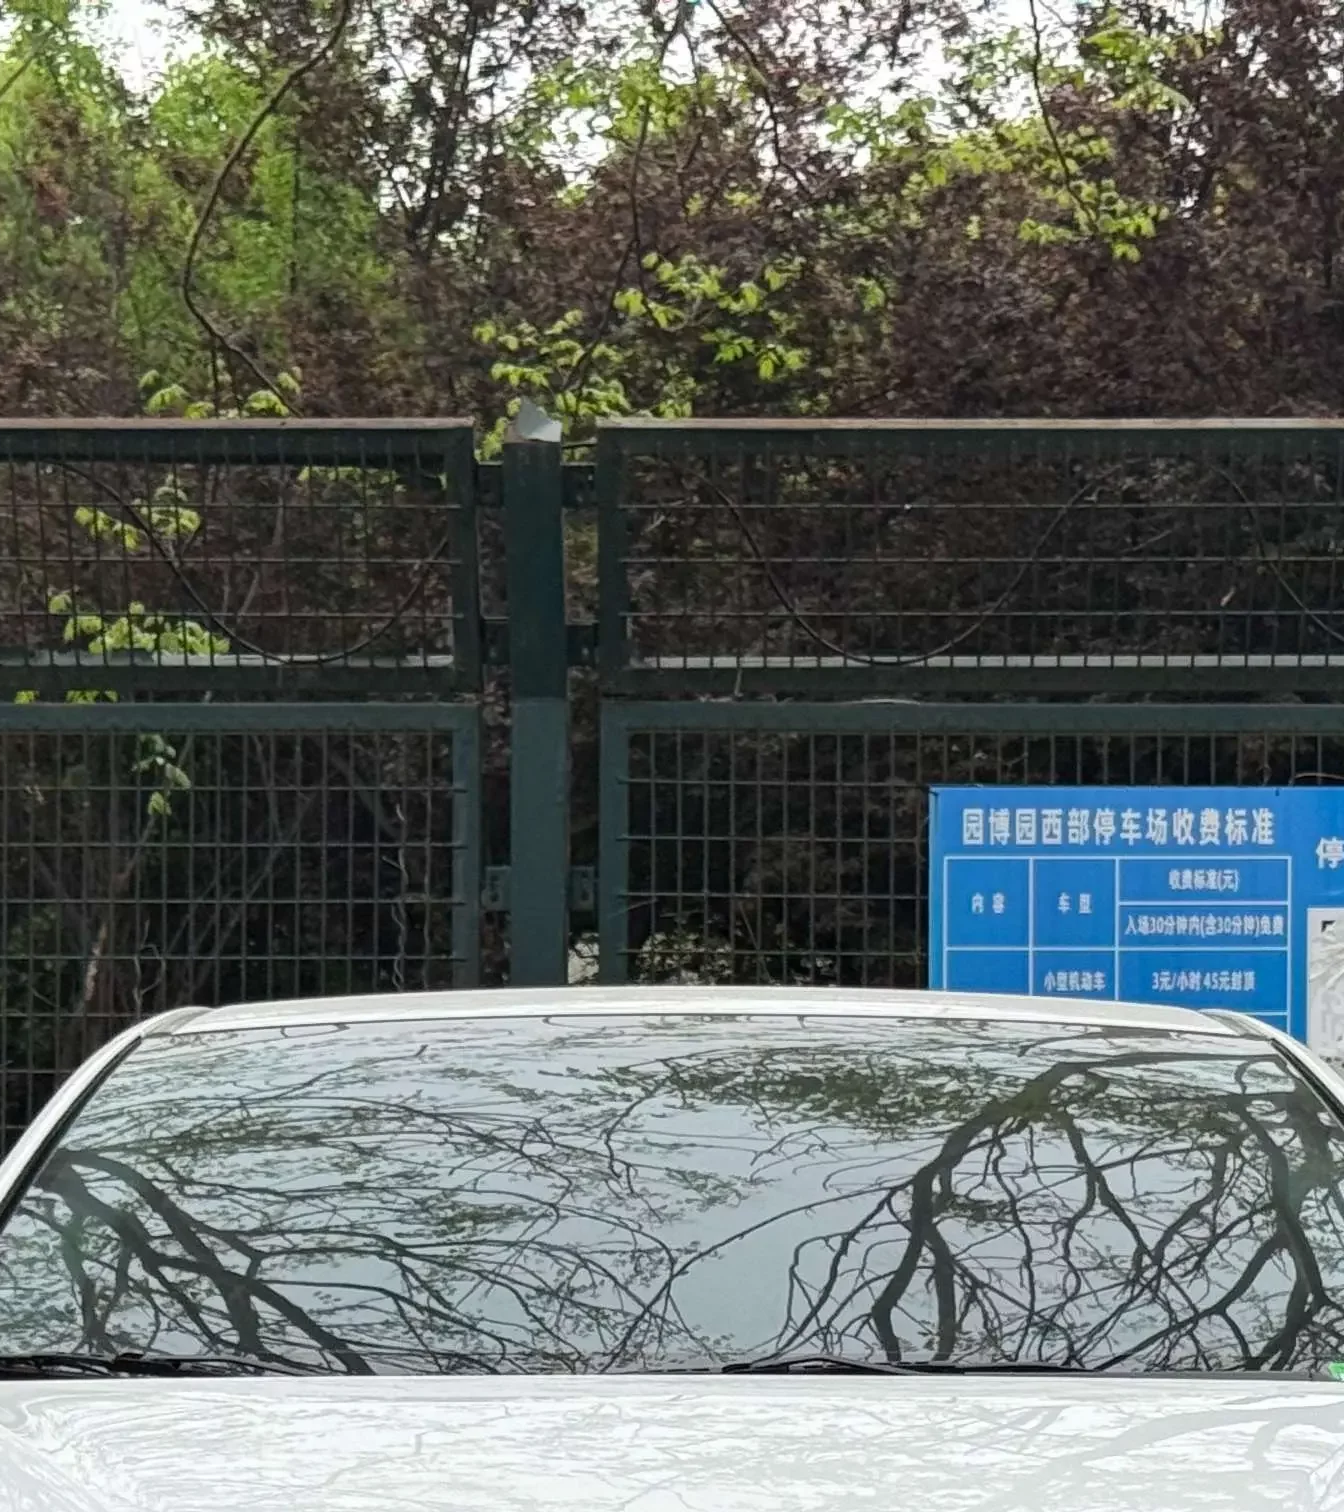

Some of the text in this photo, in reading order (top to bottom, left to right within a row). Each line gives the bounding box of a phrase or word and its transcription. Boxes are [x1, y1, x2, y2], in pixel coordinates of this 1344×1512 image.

[962, 807, 1275, 845] 园博园西部停车场收费标准
[1168, 868, 1240, 892] 收费标准(元)
